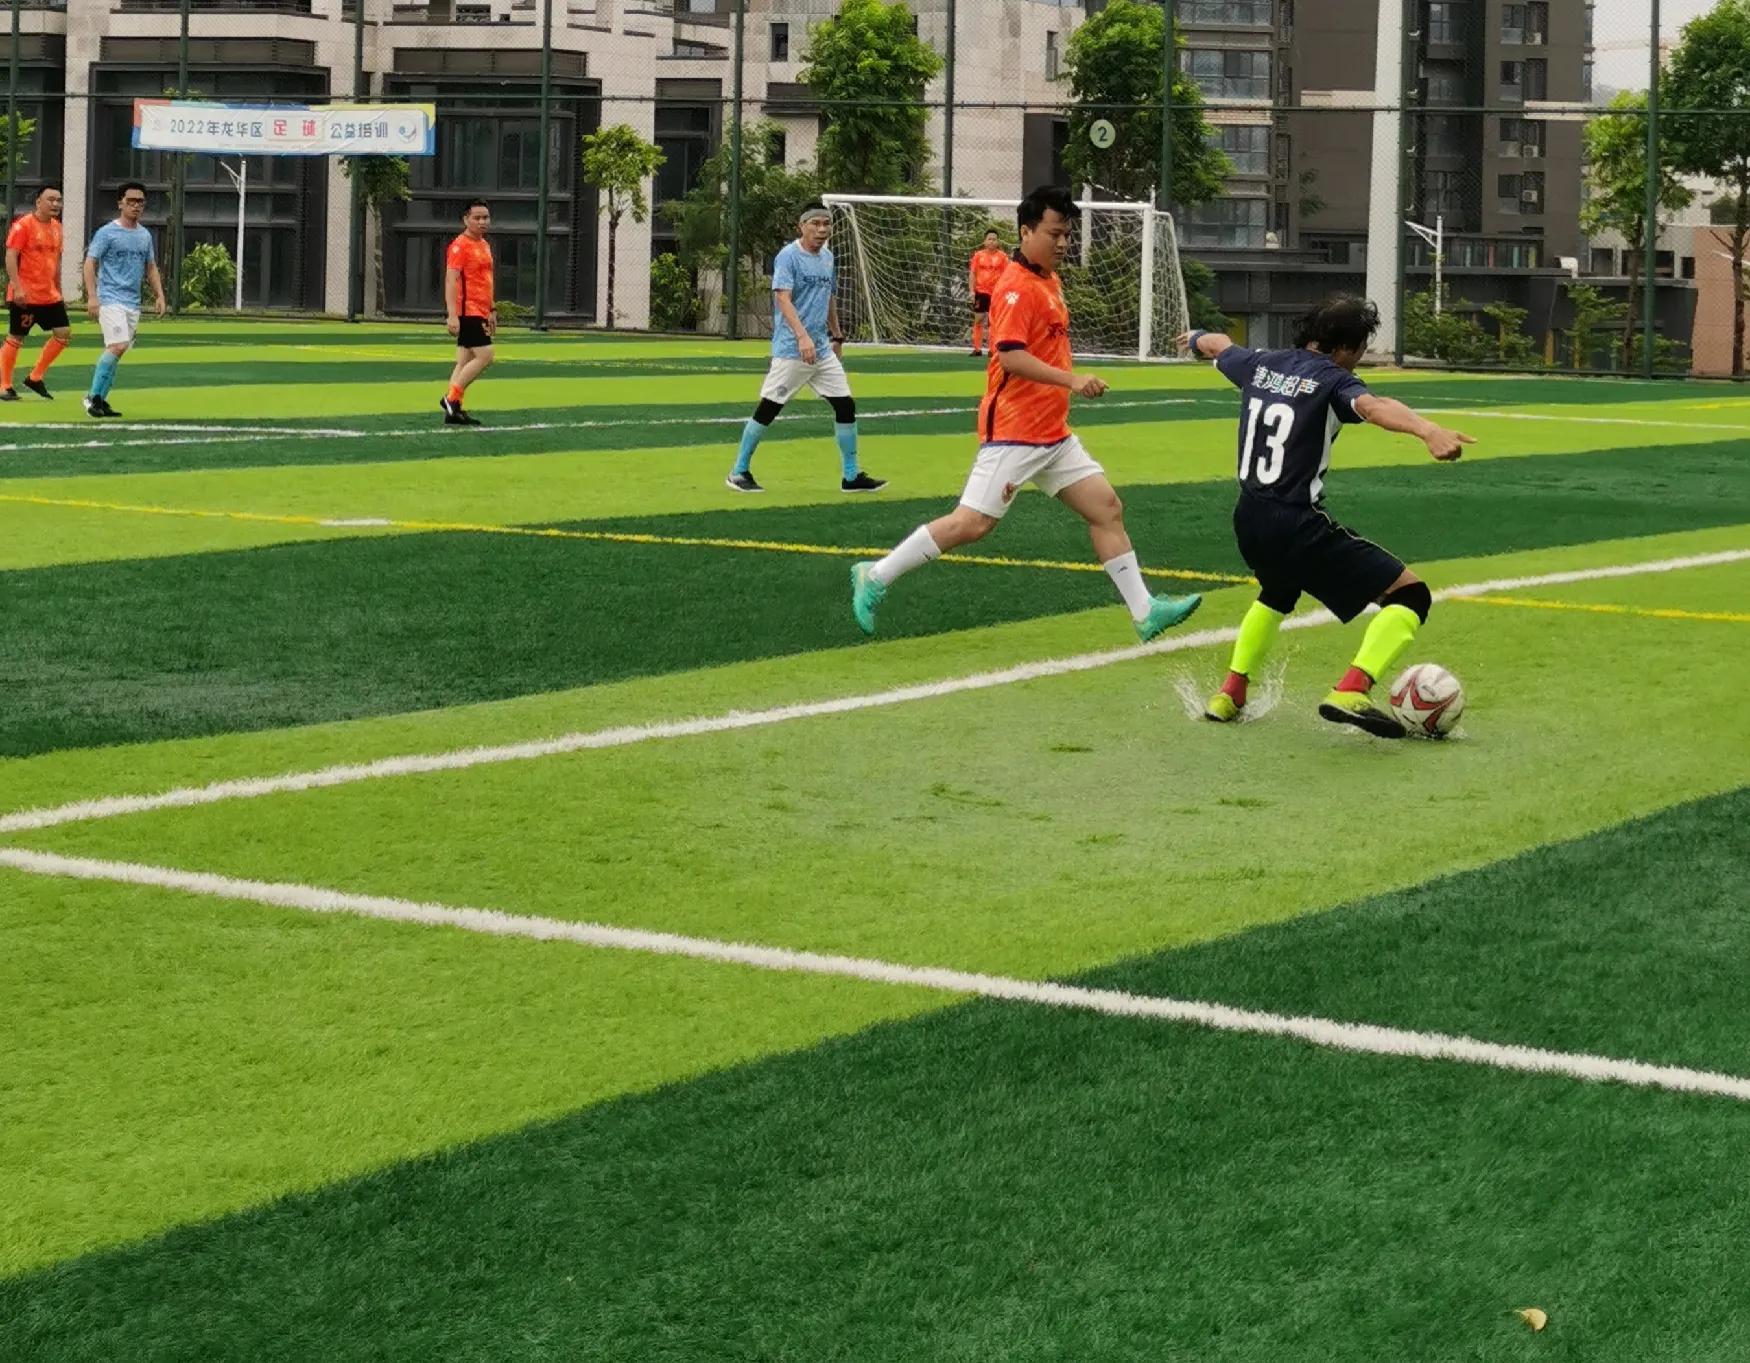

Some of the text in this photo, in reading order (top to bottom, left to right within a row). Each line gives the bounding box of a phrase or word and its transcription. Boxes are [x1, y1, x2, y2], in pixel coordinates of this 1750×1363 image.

[170, 119, 263, 137] 2022年龙华区
[330, 121, 388, 139] 公益培训
[1097, 126, 1108, 142] 2
[1239, 397, 1295, 485] 13
